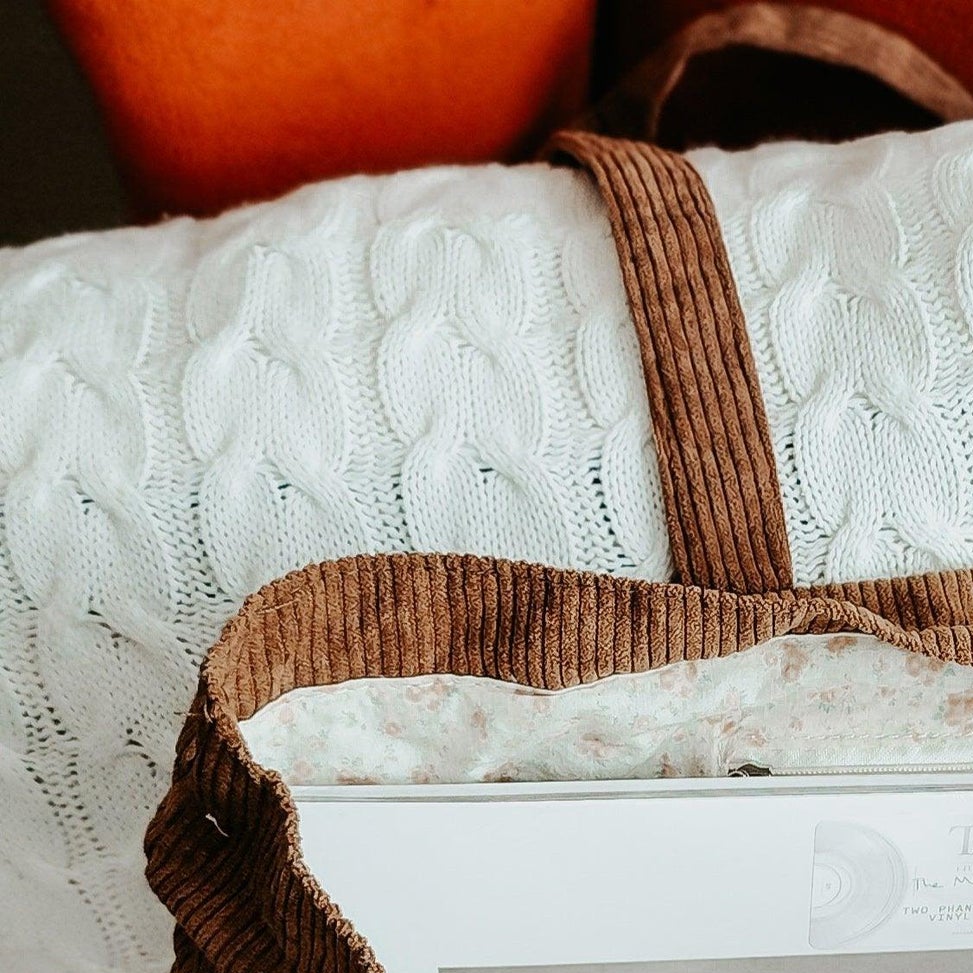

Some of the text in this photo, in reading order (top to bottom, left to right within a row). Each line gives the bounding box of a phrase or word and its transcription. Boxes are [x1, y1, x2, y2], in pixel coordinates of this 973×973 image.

[912, 877, 944, 891] The
[903, 905, 929, 916] TWO
[929, 912, 970, 922] VINYL
